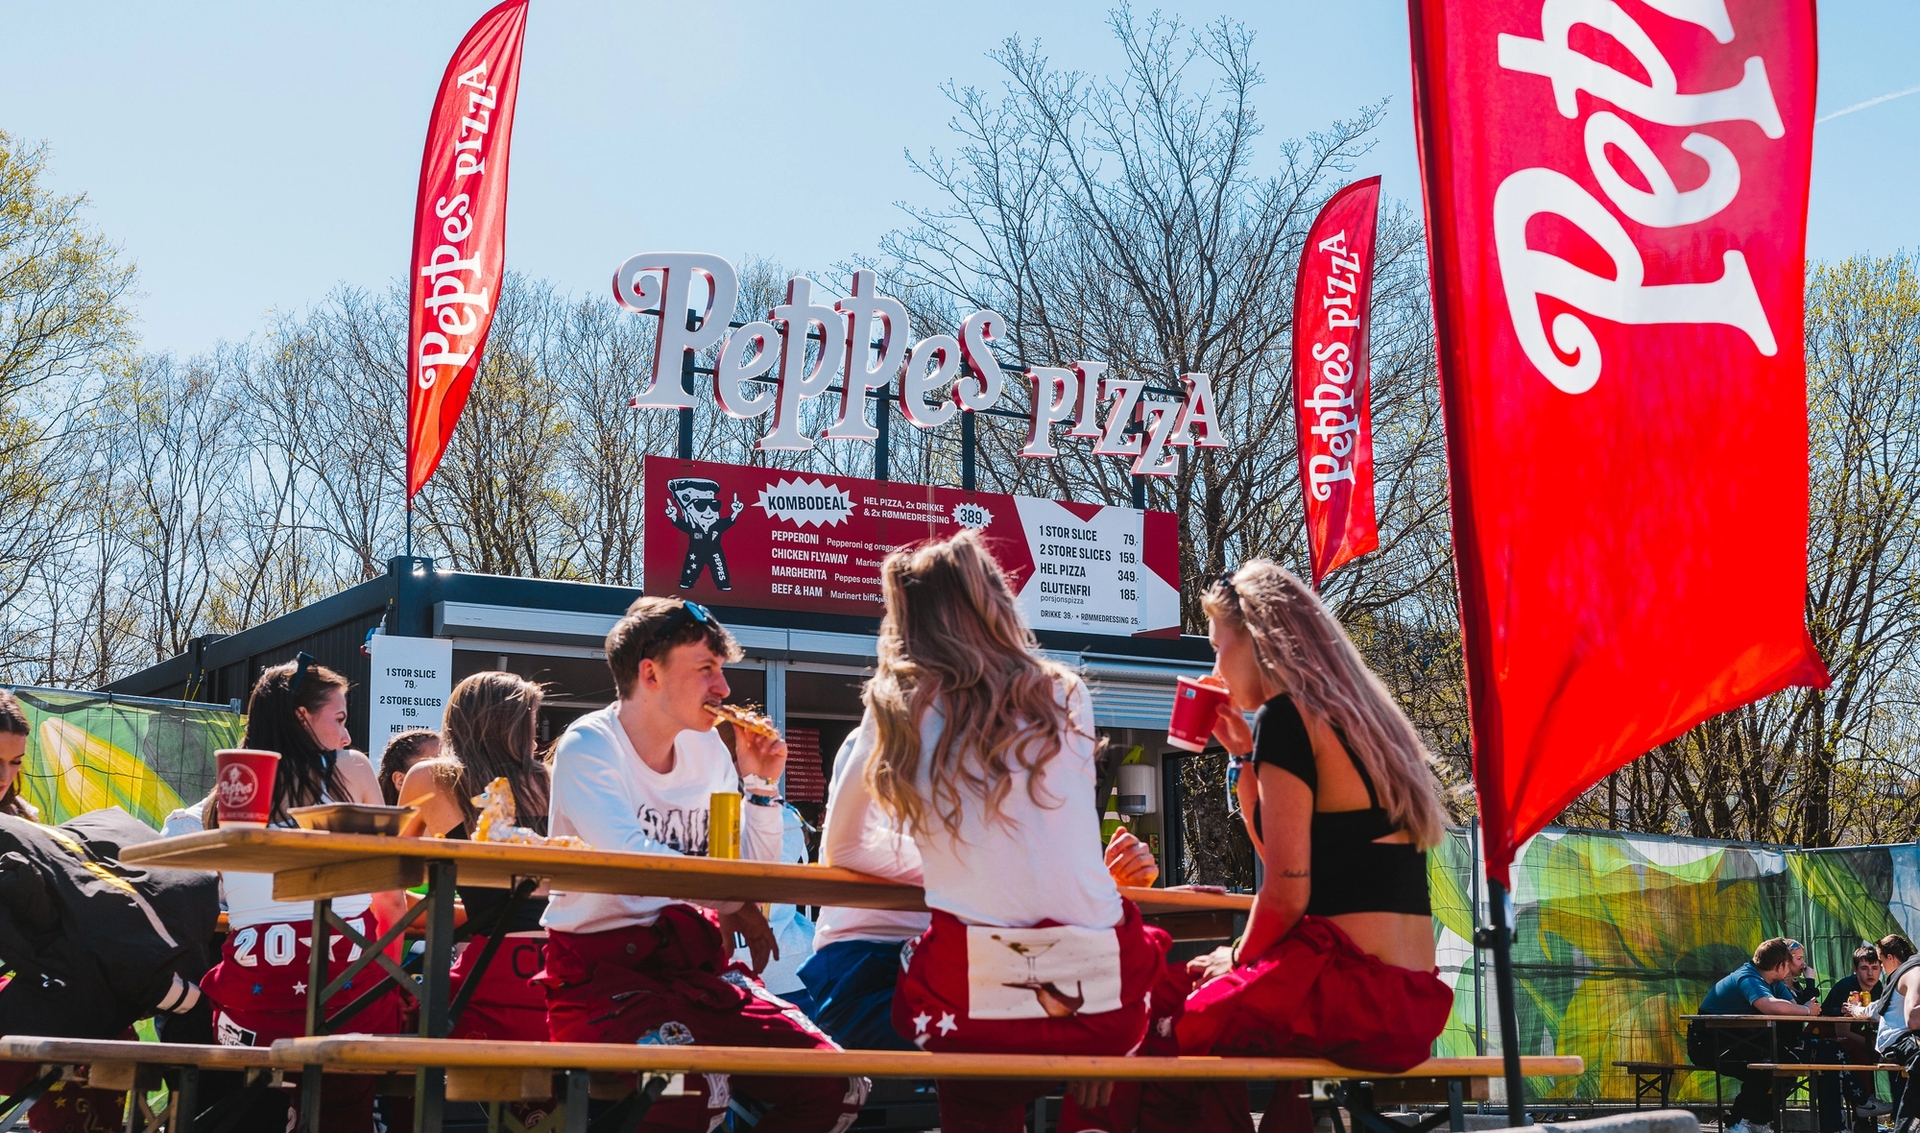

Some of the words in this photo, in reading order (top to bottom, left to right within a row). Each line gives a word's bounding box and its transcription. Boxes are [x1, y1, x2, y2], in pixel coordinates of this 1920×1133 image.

[418, 194, 491, 391] Peppes
[611, 251, 1007, 451] Peppes
[1304, 341, 1361, 502] Peppes
[768, 495, 847, 511] KOMBODEAL
[863, 496, 879, 506] HEL
[880, 498, 905, 510] PIZZA,
[905, 502, 915, 510] 2x
[916, 502, 944, 513] DRIKKE
[863, 508, 870, 516] &
[871, 509, 881, 517] 2x
[881, 510, 950, 525] RØMMEDRESSING
[771, 530, 819, 545] PEPPERONI
[826, 537, 863, 549] Pepperoni
[864, 543, 873, 551] og
[1039, 524, 1044, 536] 1
[1045, 525, 1070, 539] STOR
[1071, 528, 1097, 541] SLICE
[771, 547, 810, 562] CHICKEN
[811, 551, 848, 565] FLYAWAY
[1039, 543, 1046, 555] 2
[1047, 544, 1077, 558] STORE
[1079, 547, 1112, 562] SLICES
[712, 553, 726, 581] PEPPES
[771, 565, 827, 580] MARGHERITA
[834, 573, 861, 584] Peppes
[861, 576, 883, 585] osteb
[1040, 562, 1058, 575] HEL
[1059, 564, 1087, 578] PIZZA
[771, 583, 793, 594] BEEF
[794, 584, 802, 595] &
[803, 586, 823, 597] HAM
[830, 590, 862, 601] Marinert
[1040, 581, 1091, 597] GLUTENFRI
[1040, 594, 1085, 605] porsjonspizza
[1040, 609, 1061, 619] DRIKKE
[1080, 612, 1129, 625] RØMMEDRESSING
[386, 667, 390, 676] 1
[391, 667, 413, 678] STOR
[413, 669, 436, 679] SLICE
[379, 695, 386, 705] 2
[386, 695, 413, 706] STORE
[413, 697, 442, 707] SLICES
